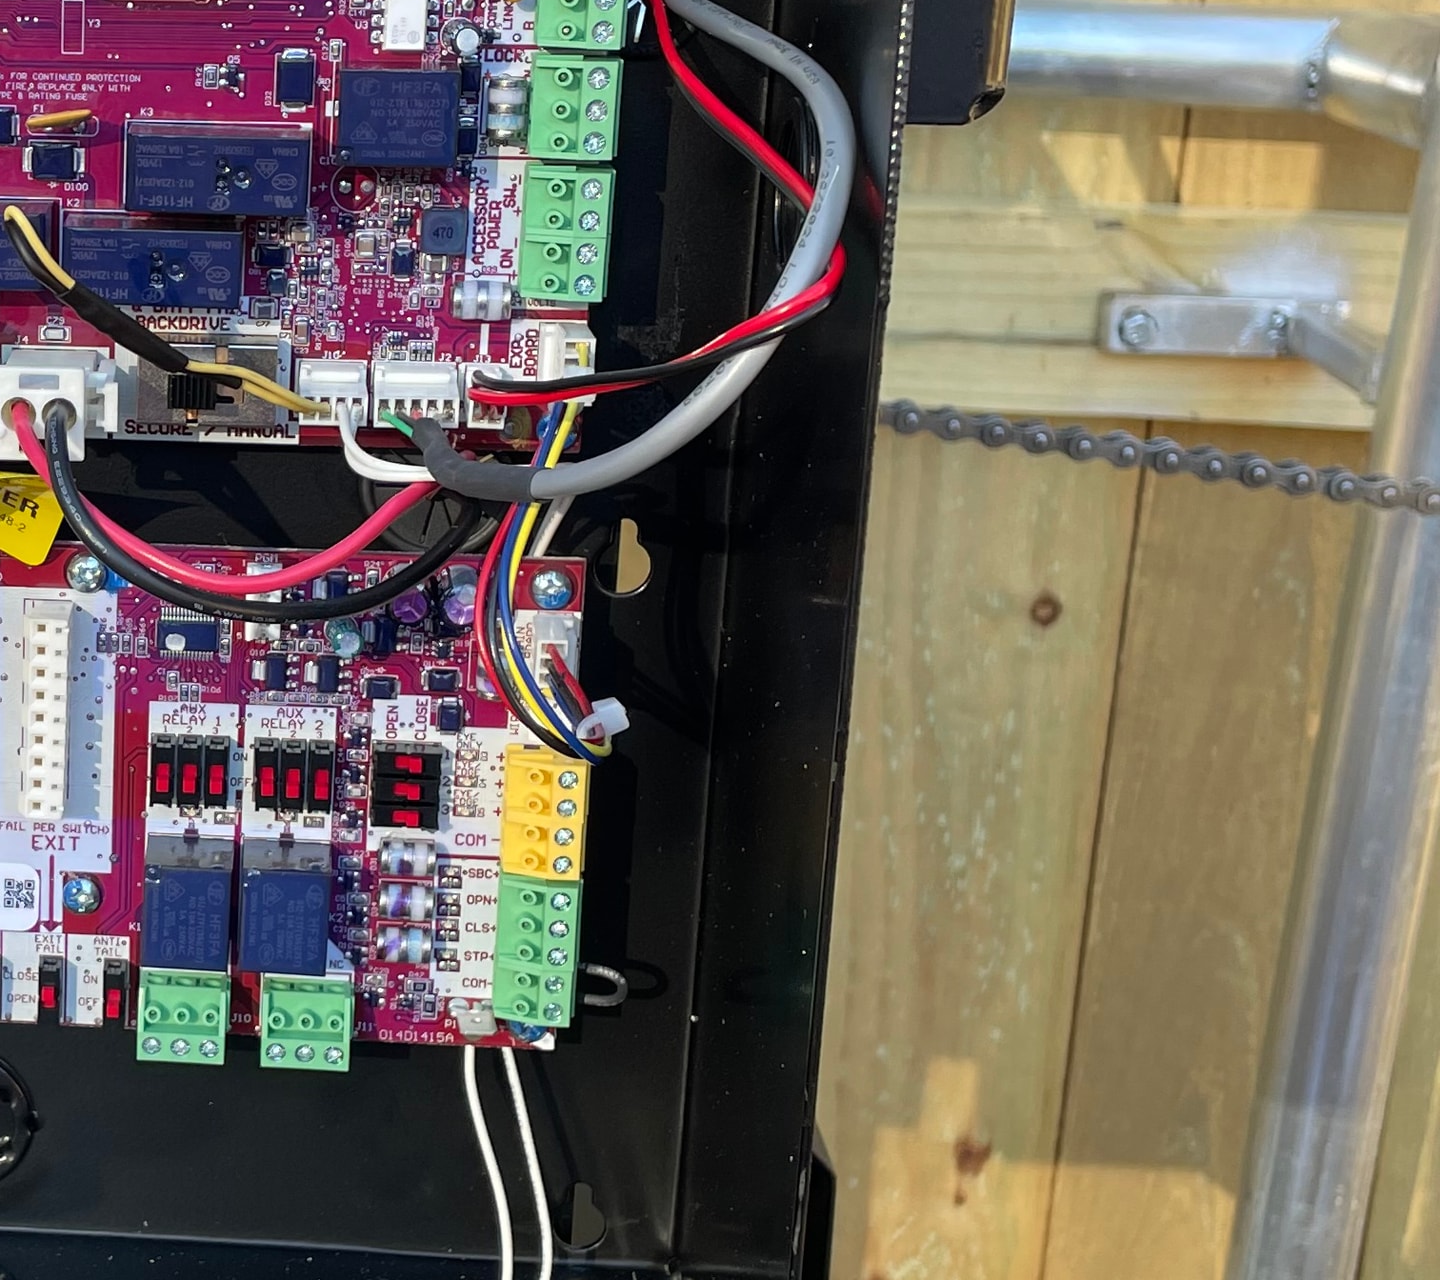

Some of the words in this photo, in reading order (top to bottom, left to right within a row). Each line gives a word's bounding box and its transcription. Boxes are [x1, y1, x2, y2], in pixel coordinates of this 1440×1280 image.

[32, 73, 79, 81] CONTINUED
[86, 74, 141, 82] PROTECTION
[38, 83, 75, 91] REPLACE
[108, 84, 131, 92] WITH
[66, 93, 88, 101] FUSE
[472, 176, 489, 264] ACCESSORY
[487, 201, 502, 250] POWER
[433, 227, 453, 239] 470
[136, 315, 231, 331] BACKDRIVE
[524, 329, 539, 376] BOARD
[125, 420, 193, 436] SECURE
[227, 424, 295, 438] MANUAL
[162, 714, 206, 726] RELAY
[261, 718, 306, 730] RELAY
[386, 705, 399, 739] OPEN
[415, 698, 428, 740] CLOSE
[33, 822, 56, 832] PER
[62, 823, 110, 835] SWITCH)
[31, 835, 81, 851] EXIT
